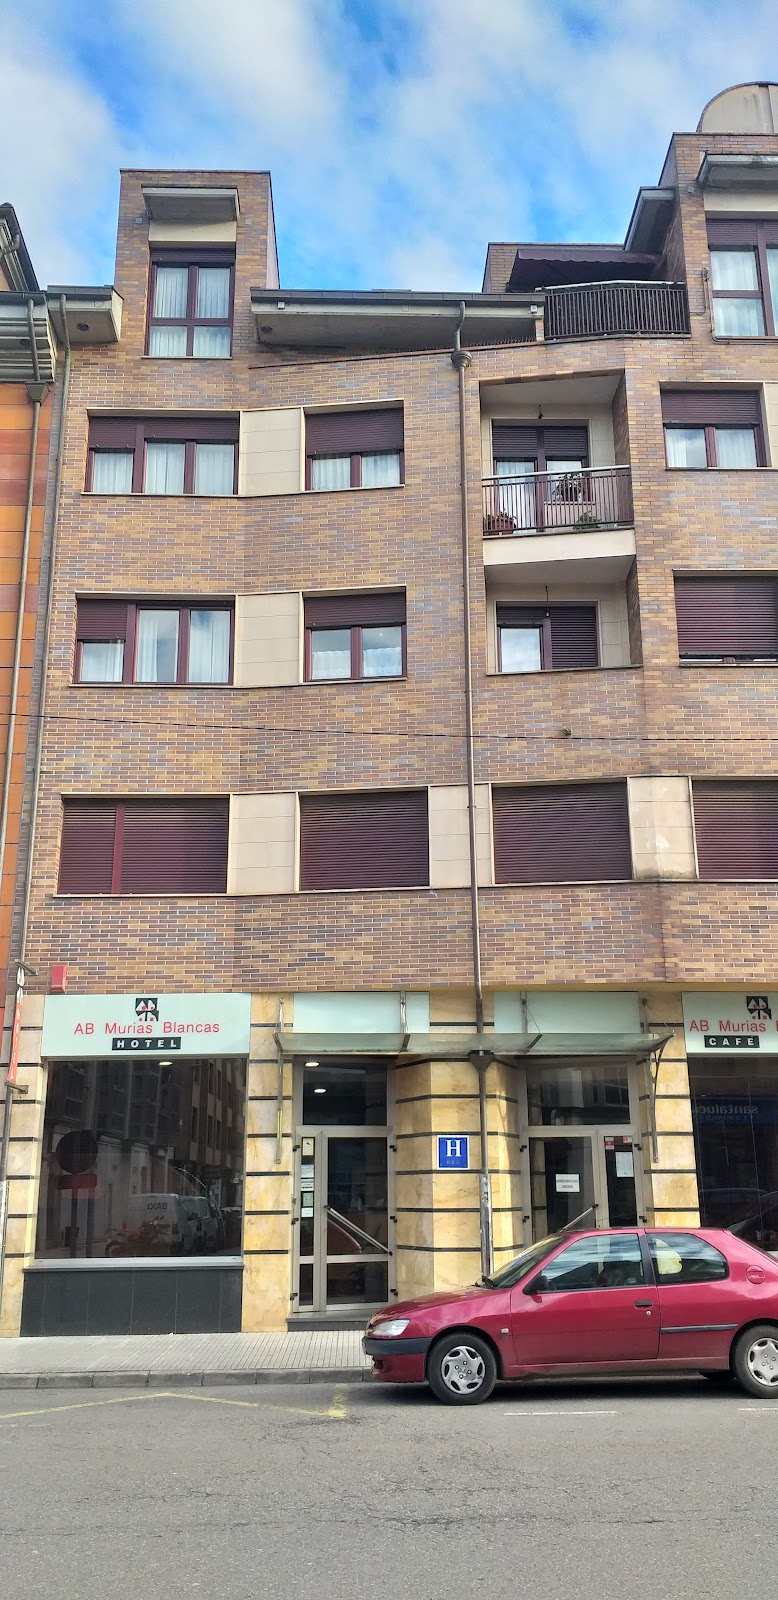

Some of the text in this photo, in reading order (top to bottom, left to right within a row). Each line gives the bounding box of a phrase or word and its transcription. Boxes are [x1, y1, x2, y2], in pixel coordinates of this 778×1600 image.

[73, 1021, 220, 1035] AB Murias Blancas
[689, 1019, 710, 1032] AB
[718, 1019, 767, 1033] Murias
[116, 1039, 177, 1049] HOTEL
[445, 1139, 462, 1158] H
